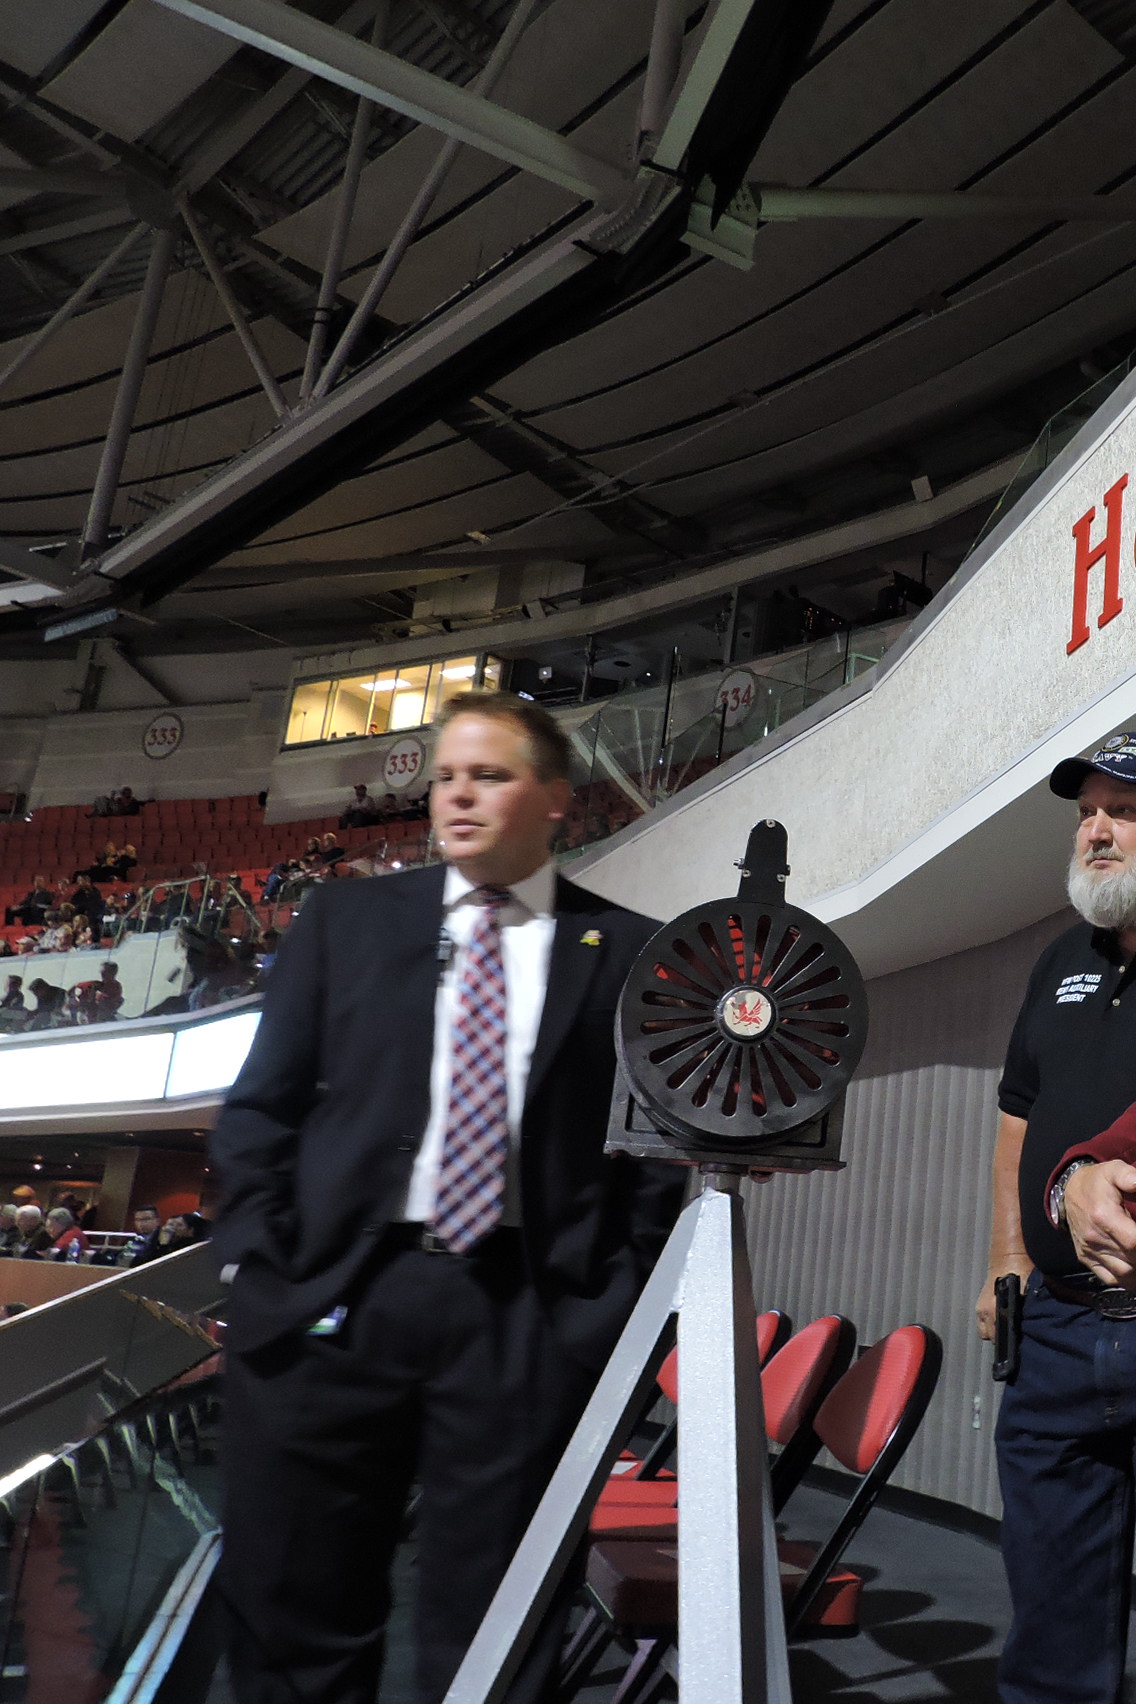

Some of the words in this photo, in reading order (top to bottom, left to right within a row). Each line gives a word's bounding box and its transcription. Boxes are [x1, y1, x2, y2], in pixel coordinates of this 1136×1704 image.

[720, 683, 753, 712] 334
[147, 727, 178, 747] 333
[386, 751, 419, 777] 333
